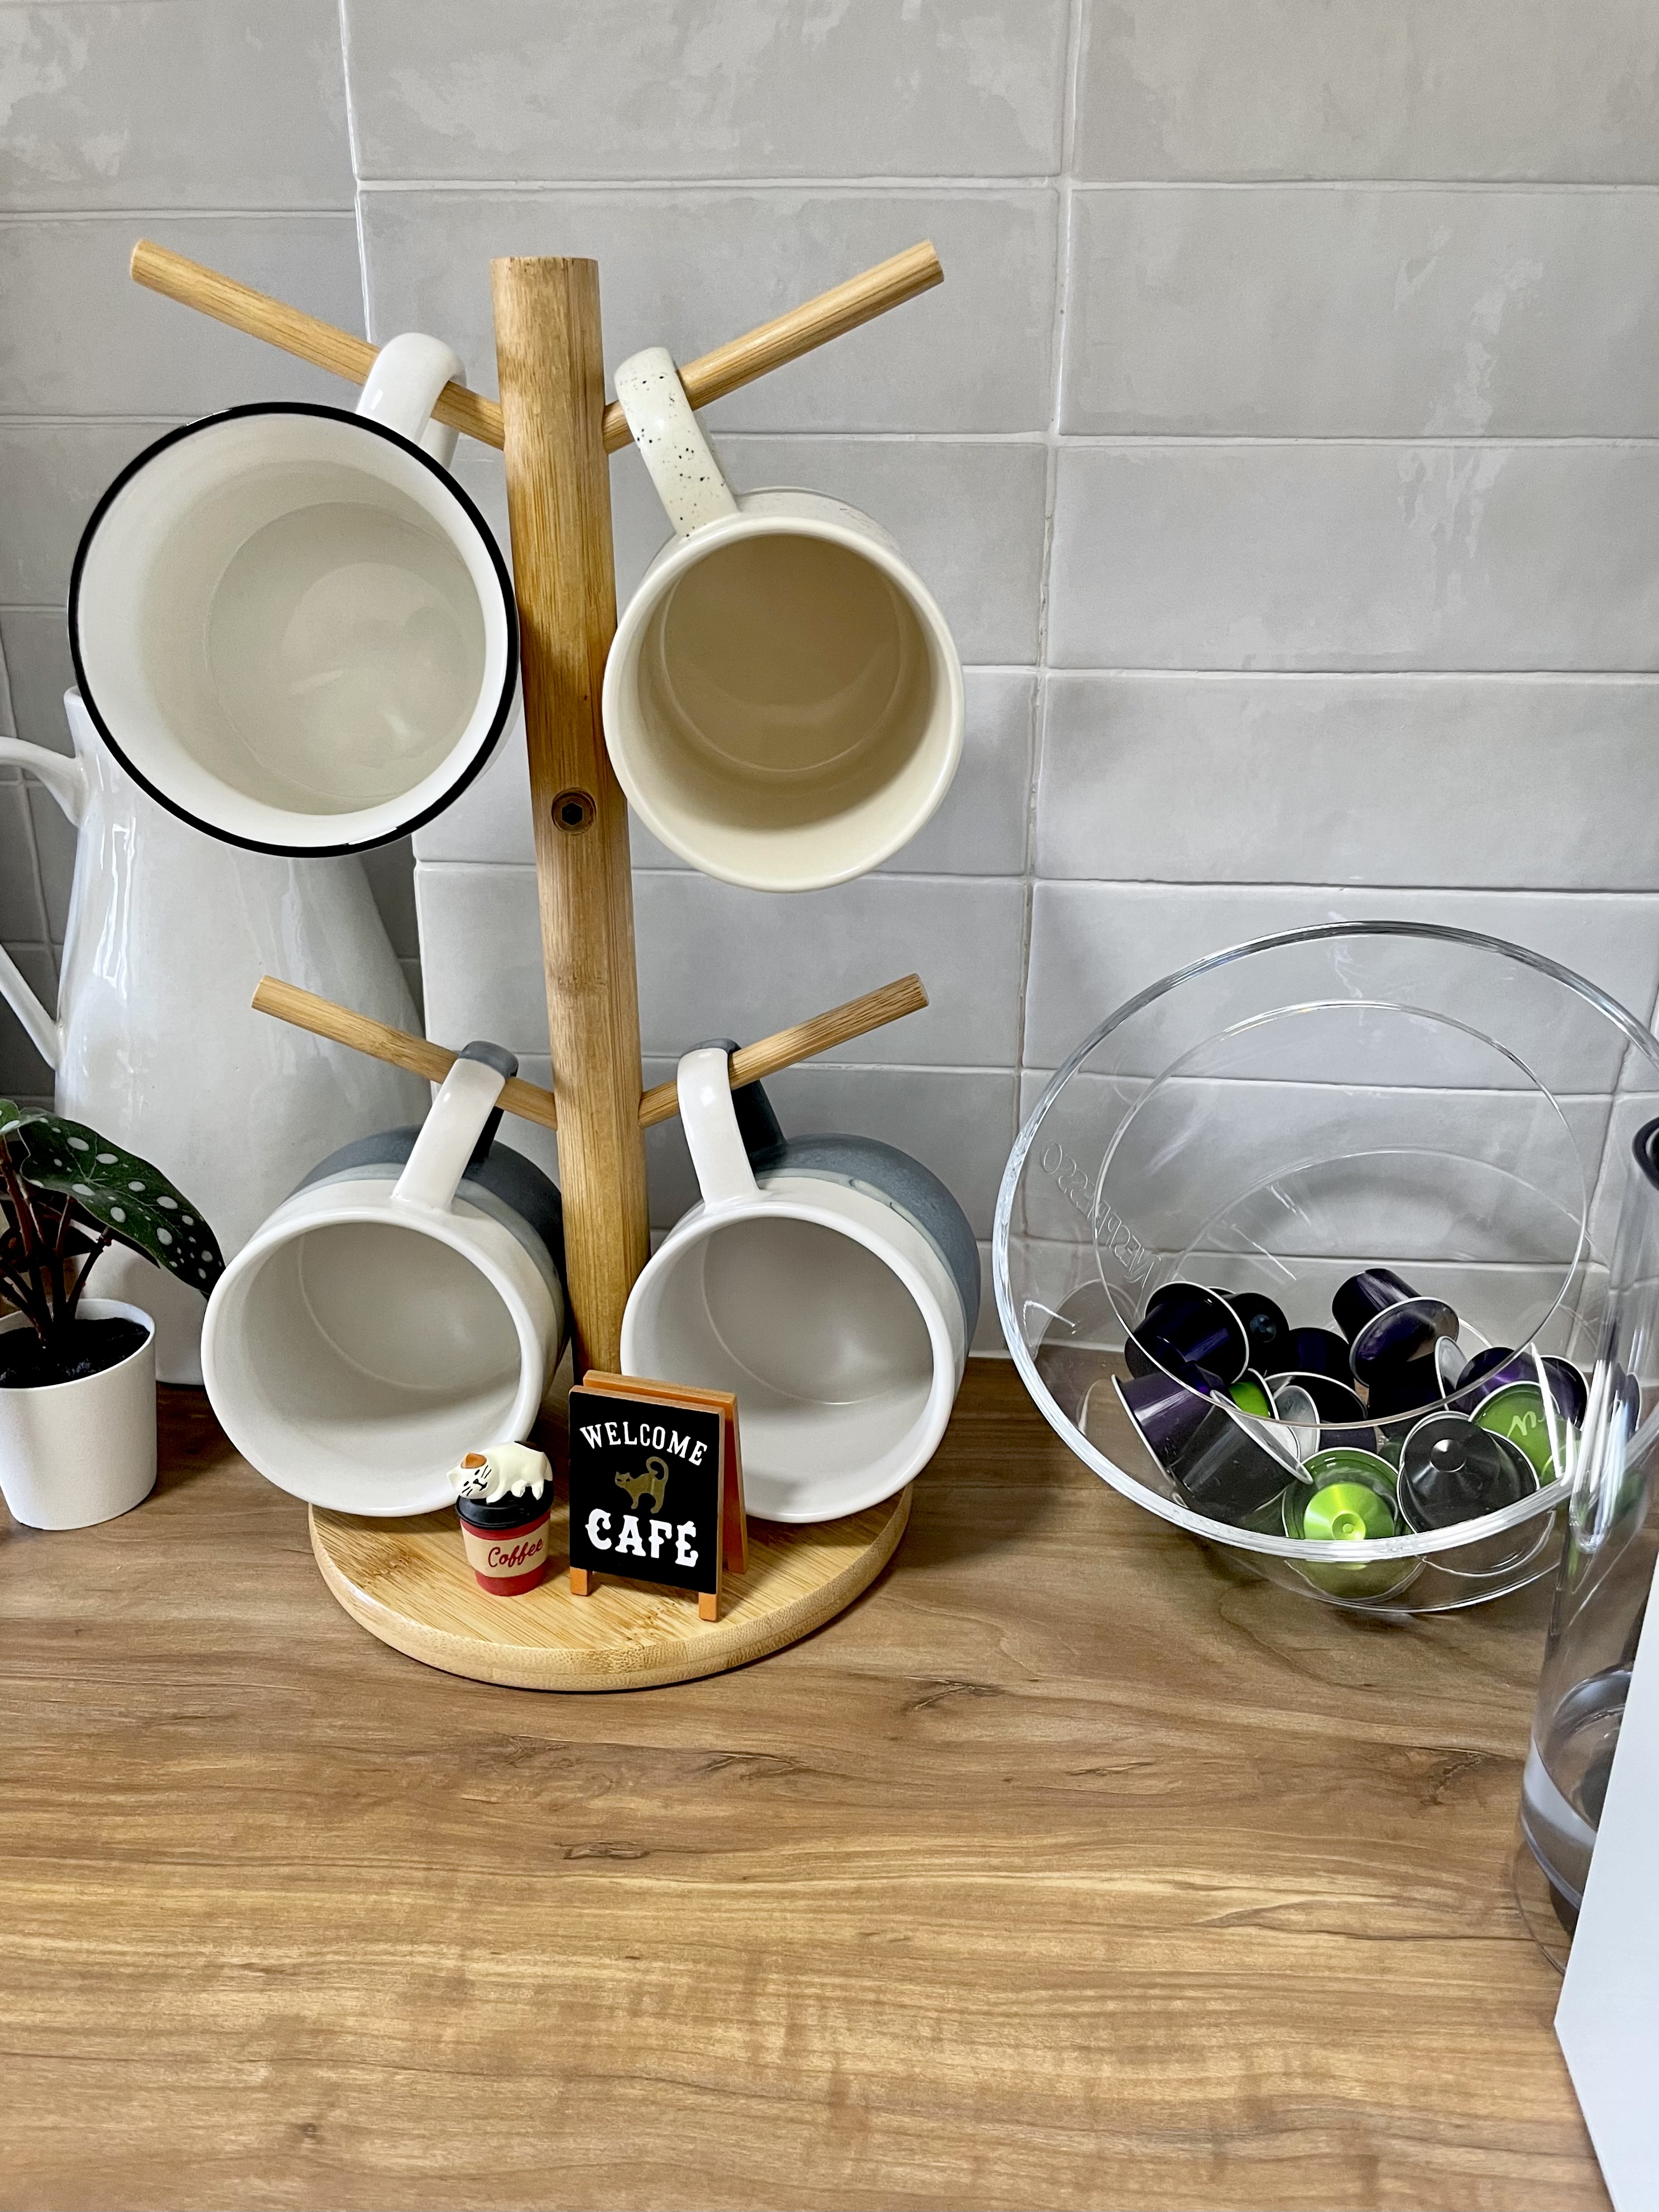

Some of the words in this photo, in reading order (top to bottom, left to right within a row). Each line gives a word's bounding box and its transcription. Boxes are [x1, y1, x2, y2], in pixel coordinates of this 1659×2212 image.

[579, 1421, 707, 1466] WELCOME
[488, 1537, 544, 1568] Coffee
[585, 1508, 698, 1567] CAFÉ
